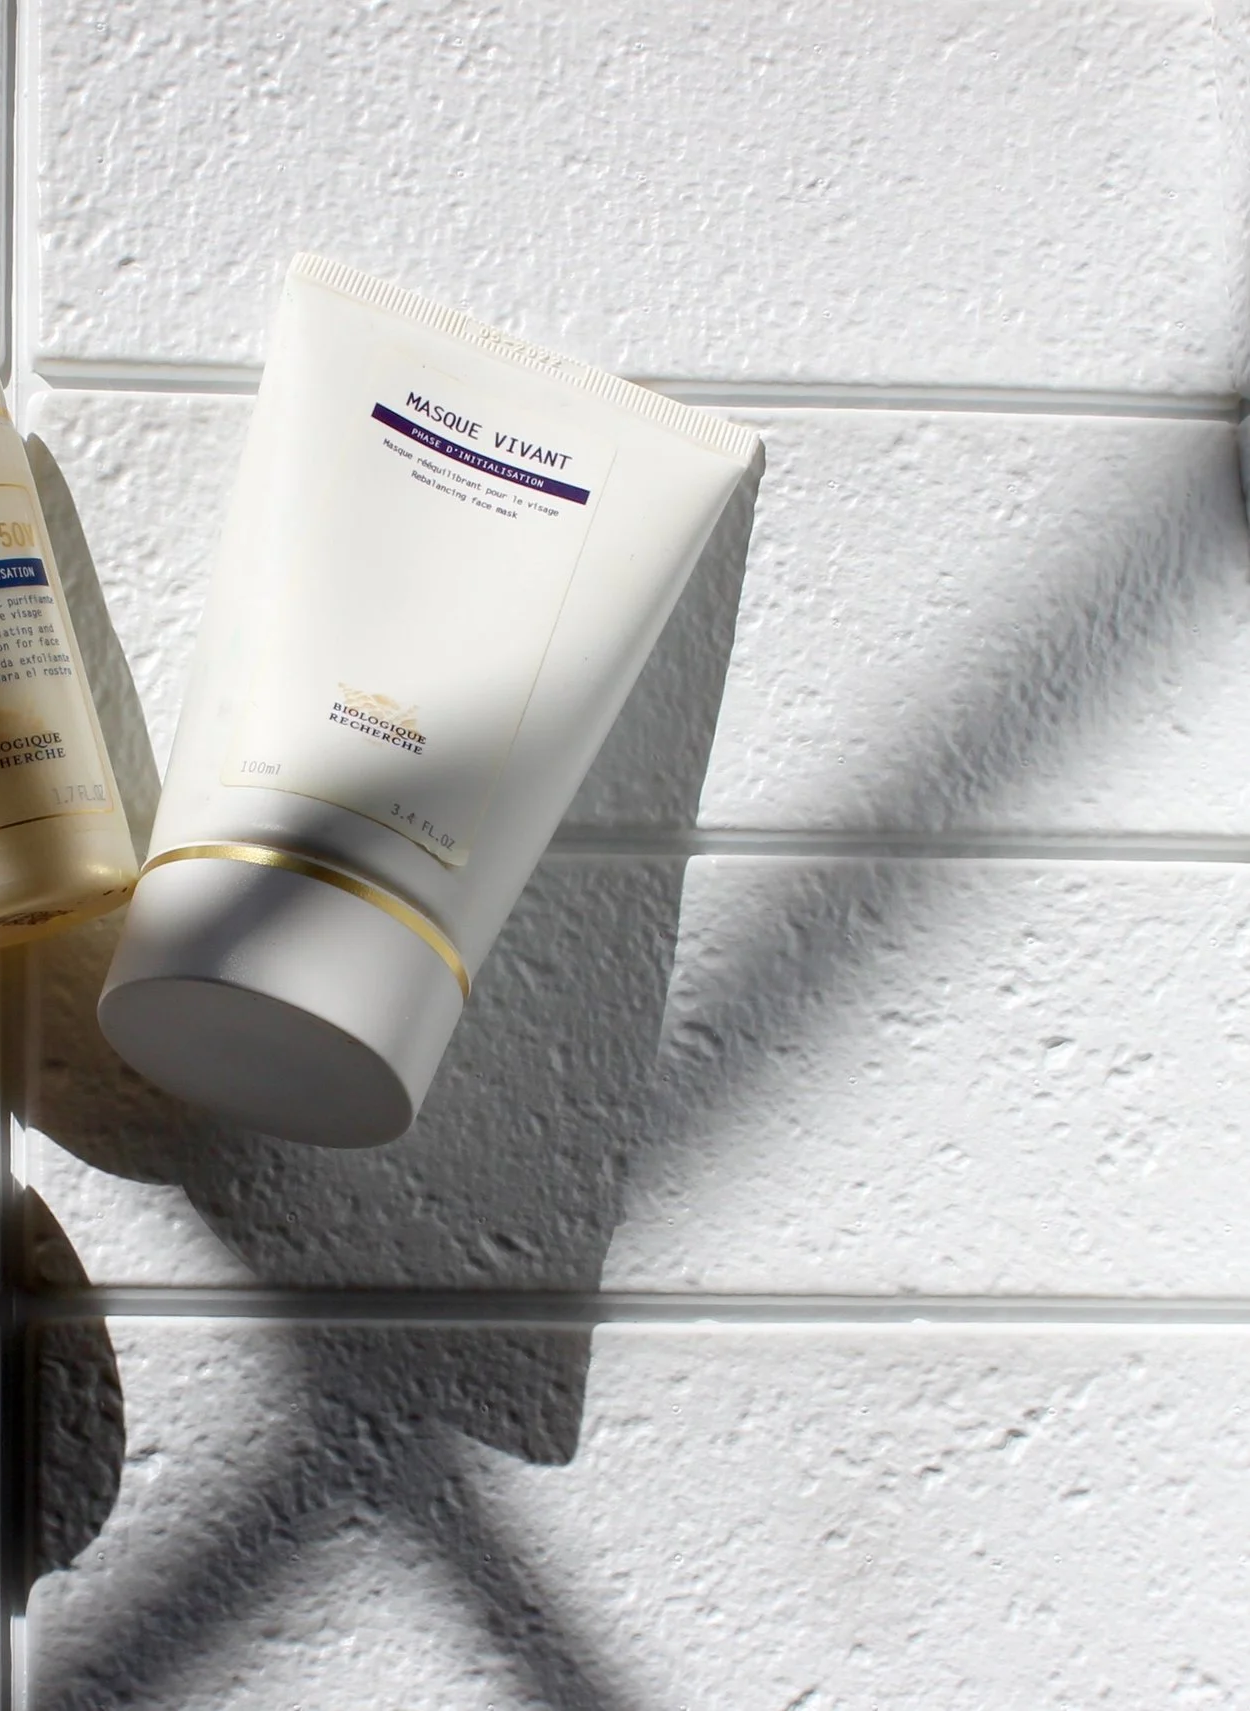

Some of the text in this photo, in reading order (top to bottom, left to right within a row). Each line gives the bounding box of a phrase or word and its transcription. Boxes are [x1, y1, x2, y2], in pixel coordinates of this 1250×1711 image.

[406, 392, 572, 470] MASQUE VIVANT
[412, 428, 544, 488] PHASE D'INITIALISATION
[383, 438, 559, 518] Masque rééquilibrant pour le visage
[411, 470, 518, 519] Rebalancing face mask
[11, 608, 42, 620] visage
[38, 623, 54, 634] and
[16, 636, 33, 648] for
[39, 636, 60, 646] face
[20, 653, 70, 666] exfoliante
[26, 667, 37, 678] el
[44, 665, 72, 676] rostro
[328, 712, 423, 755] RECHERCHE
[332, 701, 427, 745] BIOLOGIQUE
[240, 760, 282, 776] 100ml
[421, 819, 456, 851] FL.OZ
